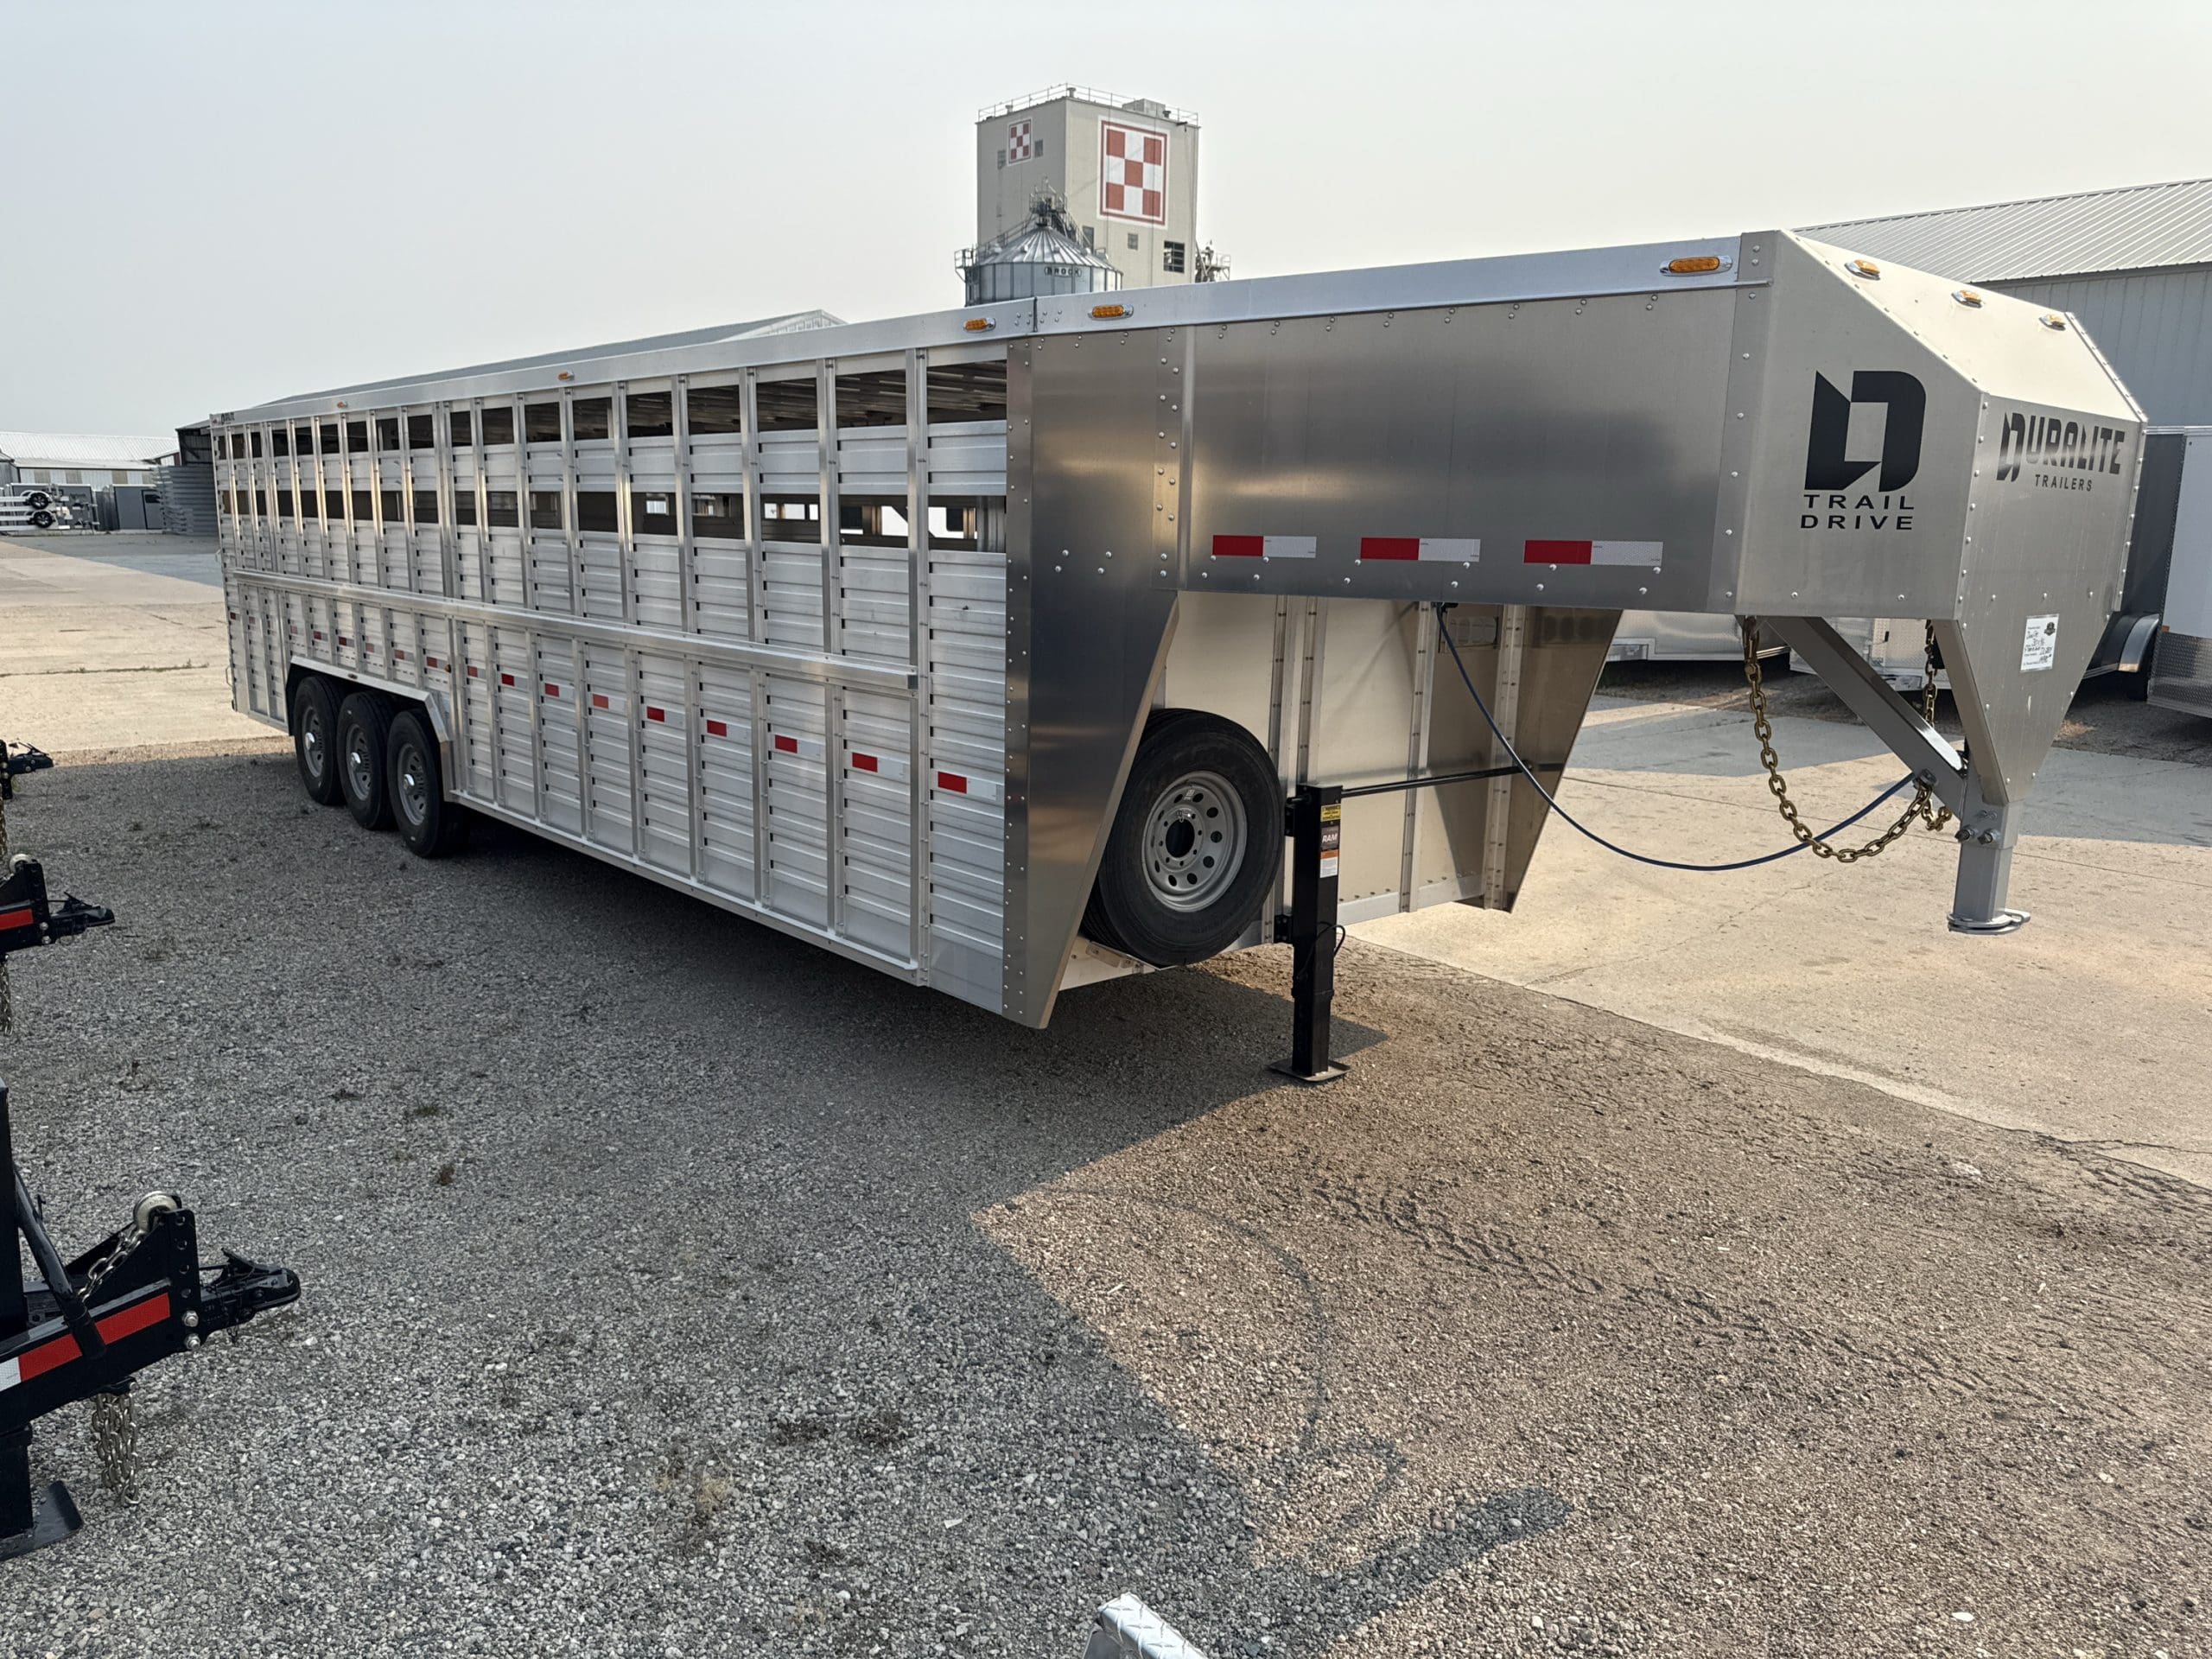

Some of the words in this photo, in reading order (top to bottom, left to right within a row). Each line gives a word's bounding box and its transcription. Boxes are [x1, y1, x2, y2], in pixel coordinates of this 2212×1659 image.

[1997, 412, 2126, 482] DURALITE
[2035, 474, 2092, 492] TRAILERS
[1803, 494, 1915, 510] TRAIL
[1800, 514, 1913, 531] DRIVE
[1322, 833, 1338, 843] RAM
